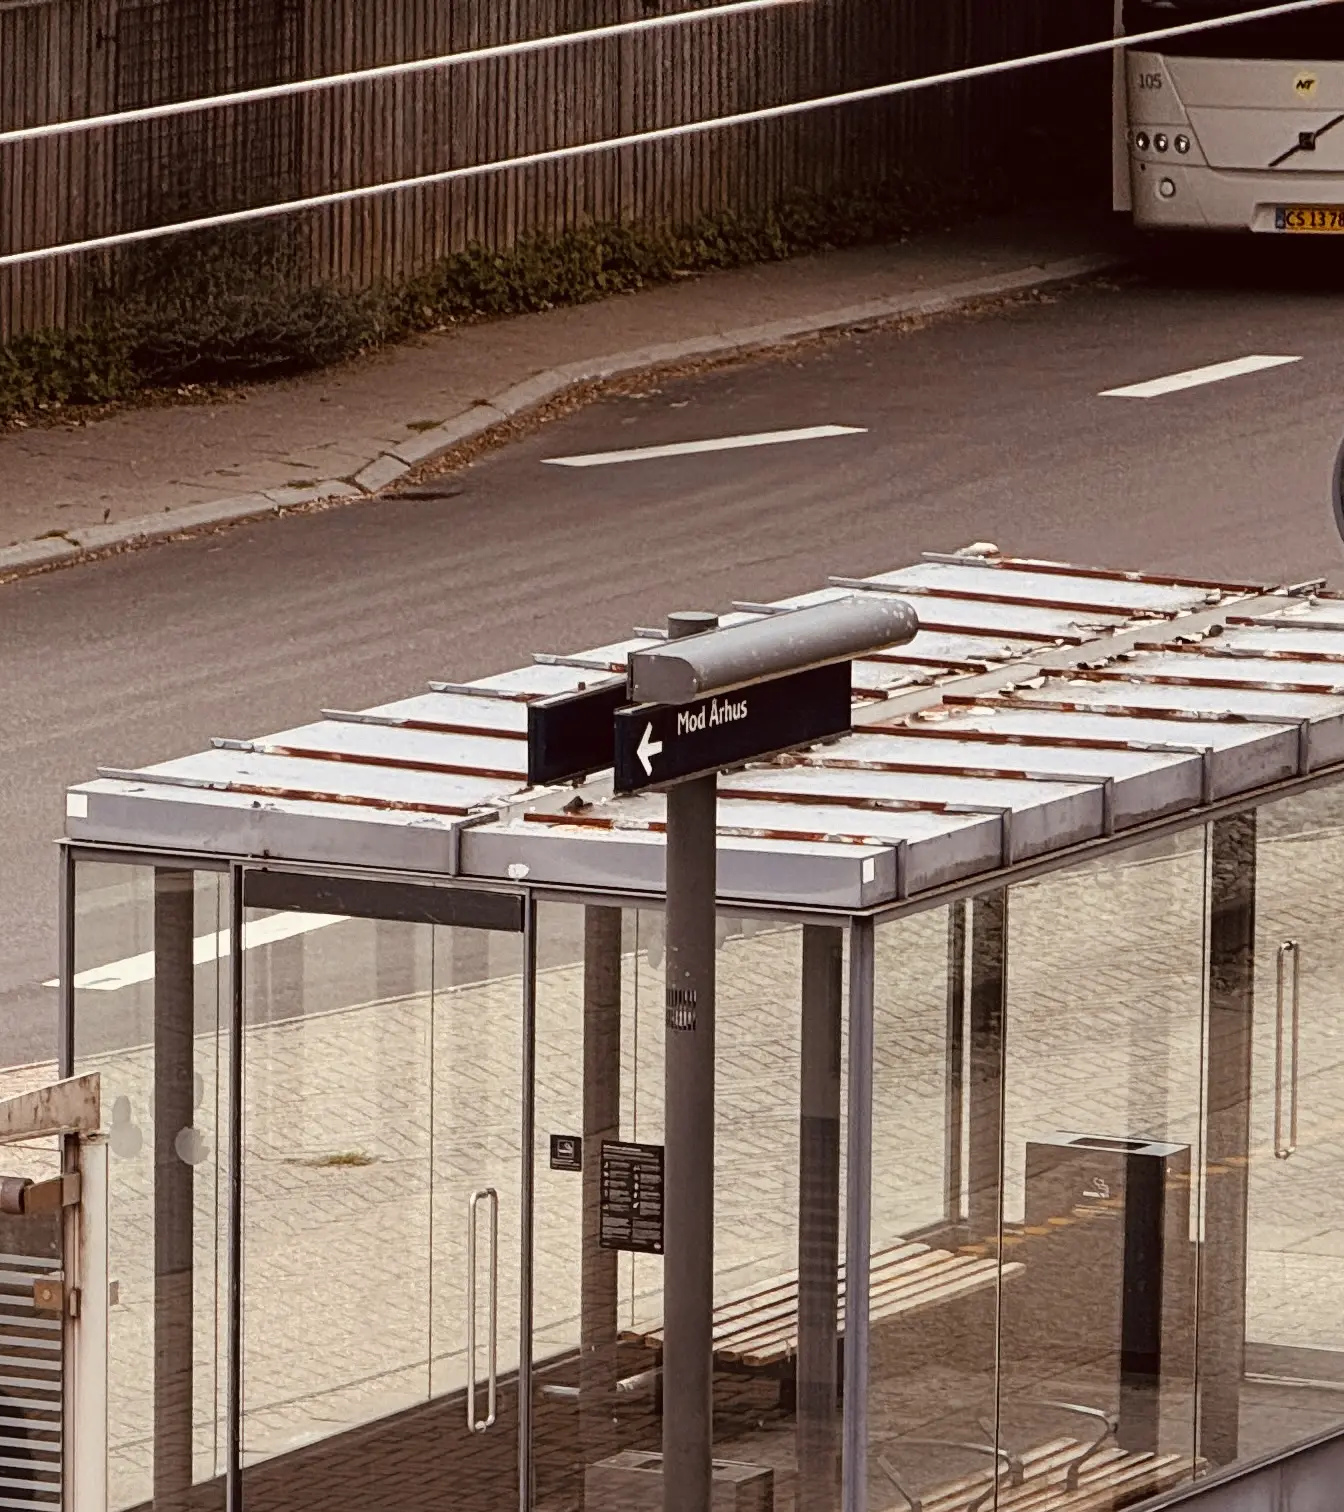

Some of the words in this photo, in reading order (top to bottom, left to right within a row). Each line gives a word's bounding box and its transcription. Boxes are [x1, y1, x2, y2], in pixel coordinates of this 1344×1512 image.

[1138, 73, 1163, 89] 105
[1286, 211, 1306, 227] CS
[1310, 211, 1326, 227] 13
[677, 705, 706, 735] Mod
[709, 697, 747, 728] Århus
